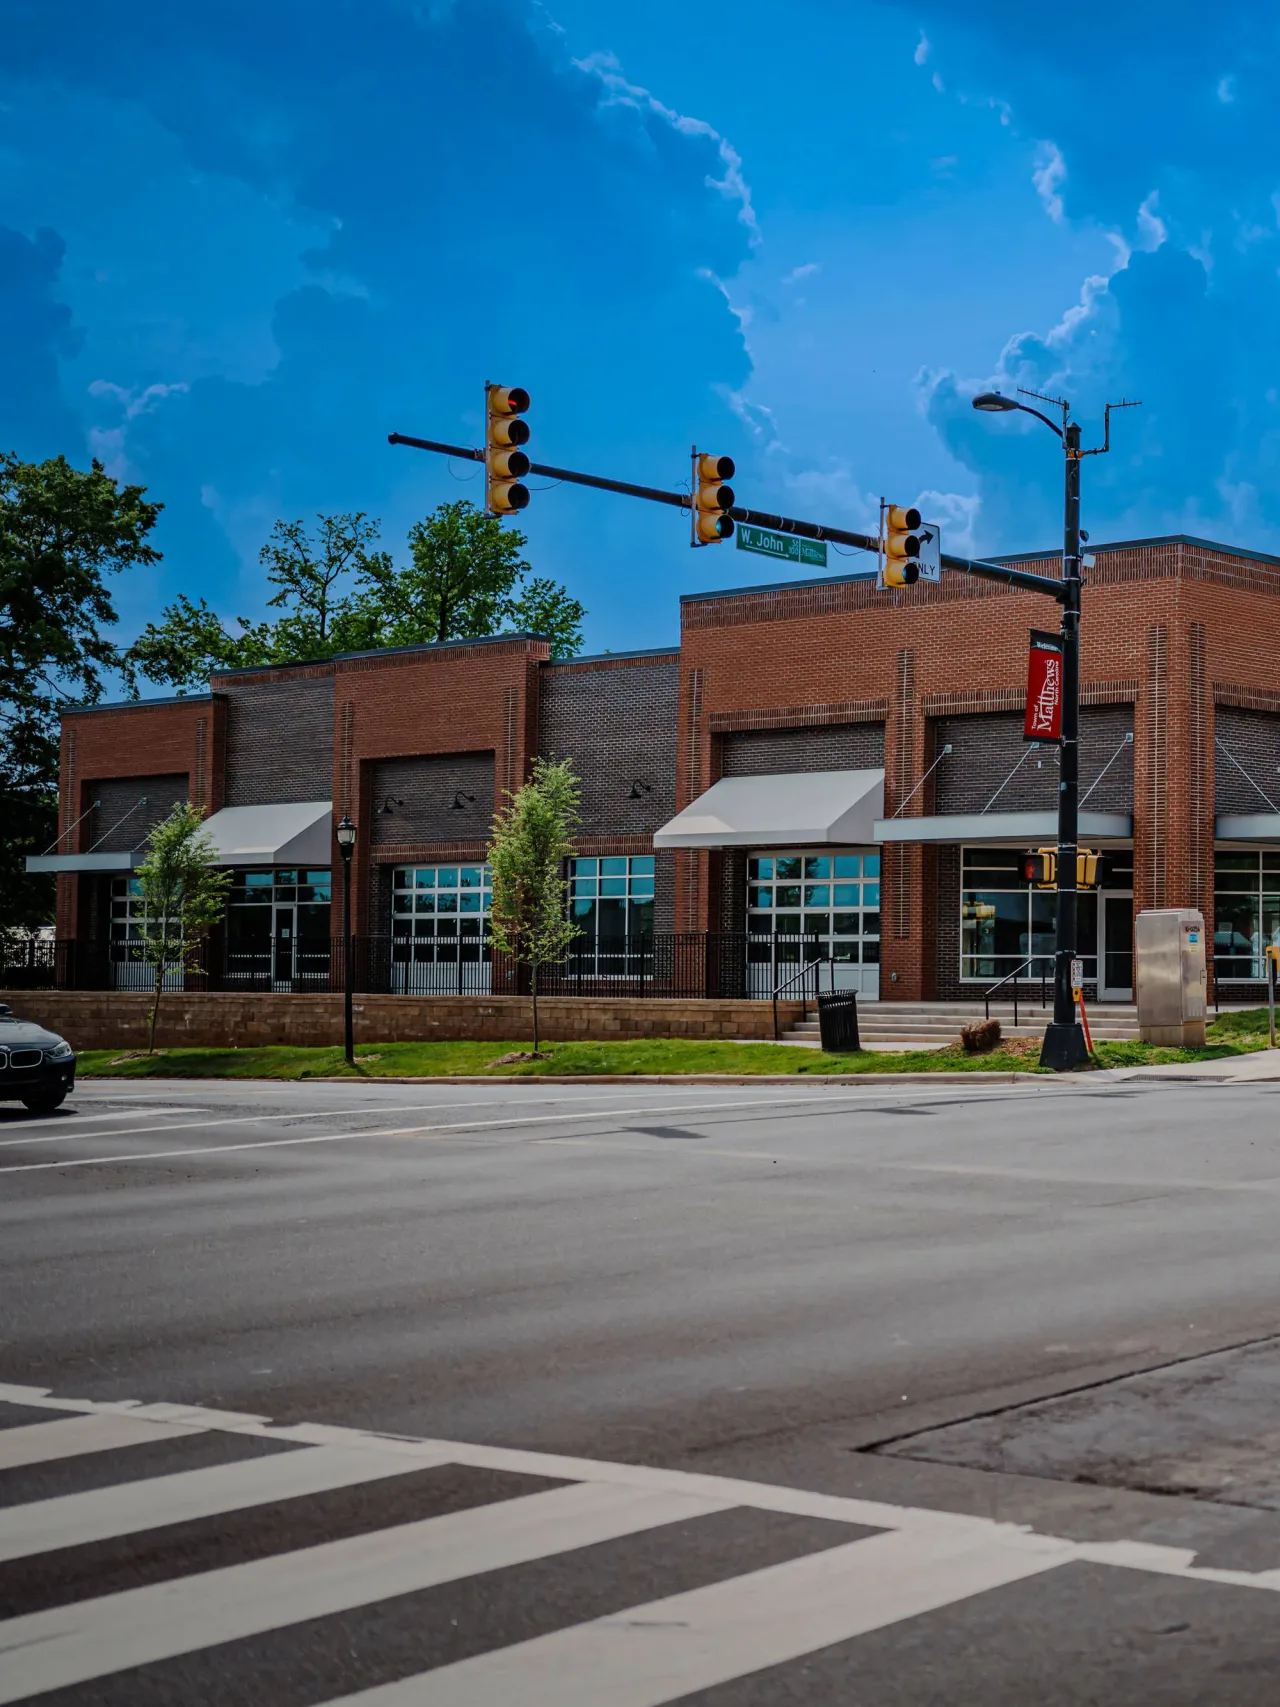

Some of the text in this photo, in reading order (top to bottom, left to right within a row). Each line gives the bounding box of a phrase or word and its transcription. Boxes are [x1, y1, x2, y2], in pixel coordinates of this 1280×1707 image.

[741, 528, 783, 551] W. John
[788, 547, 799, 555] 100
[1037, 660, 1055, 732] Matthews
